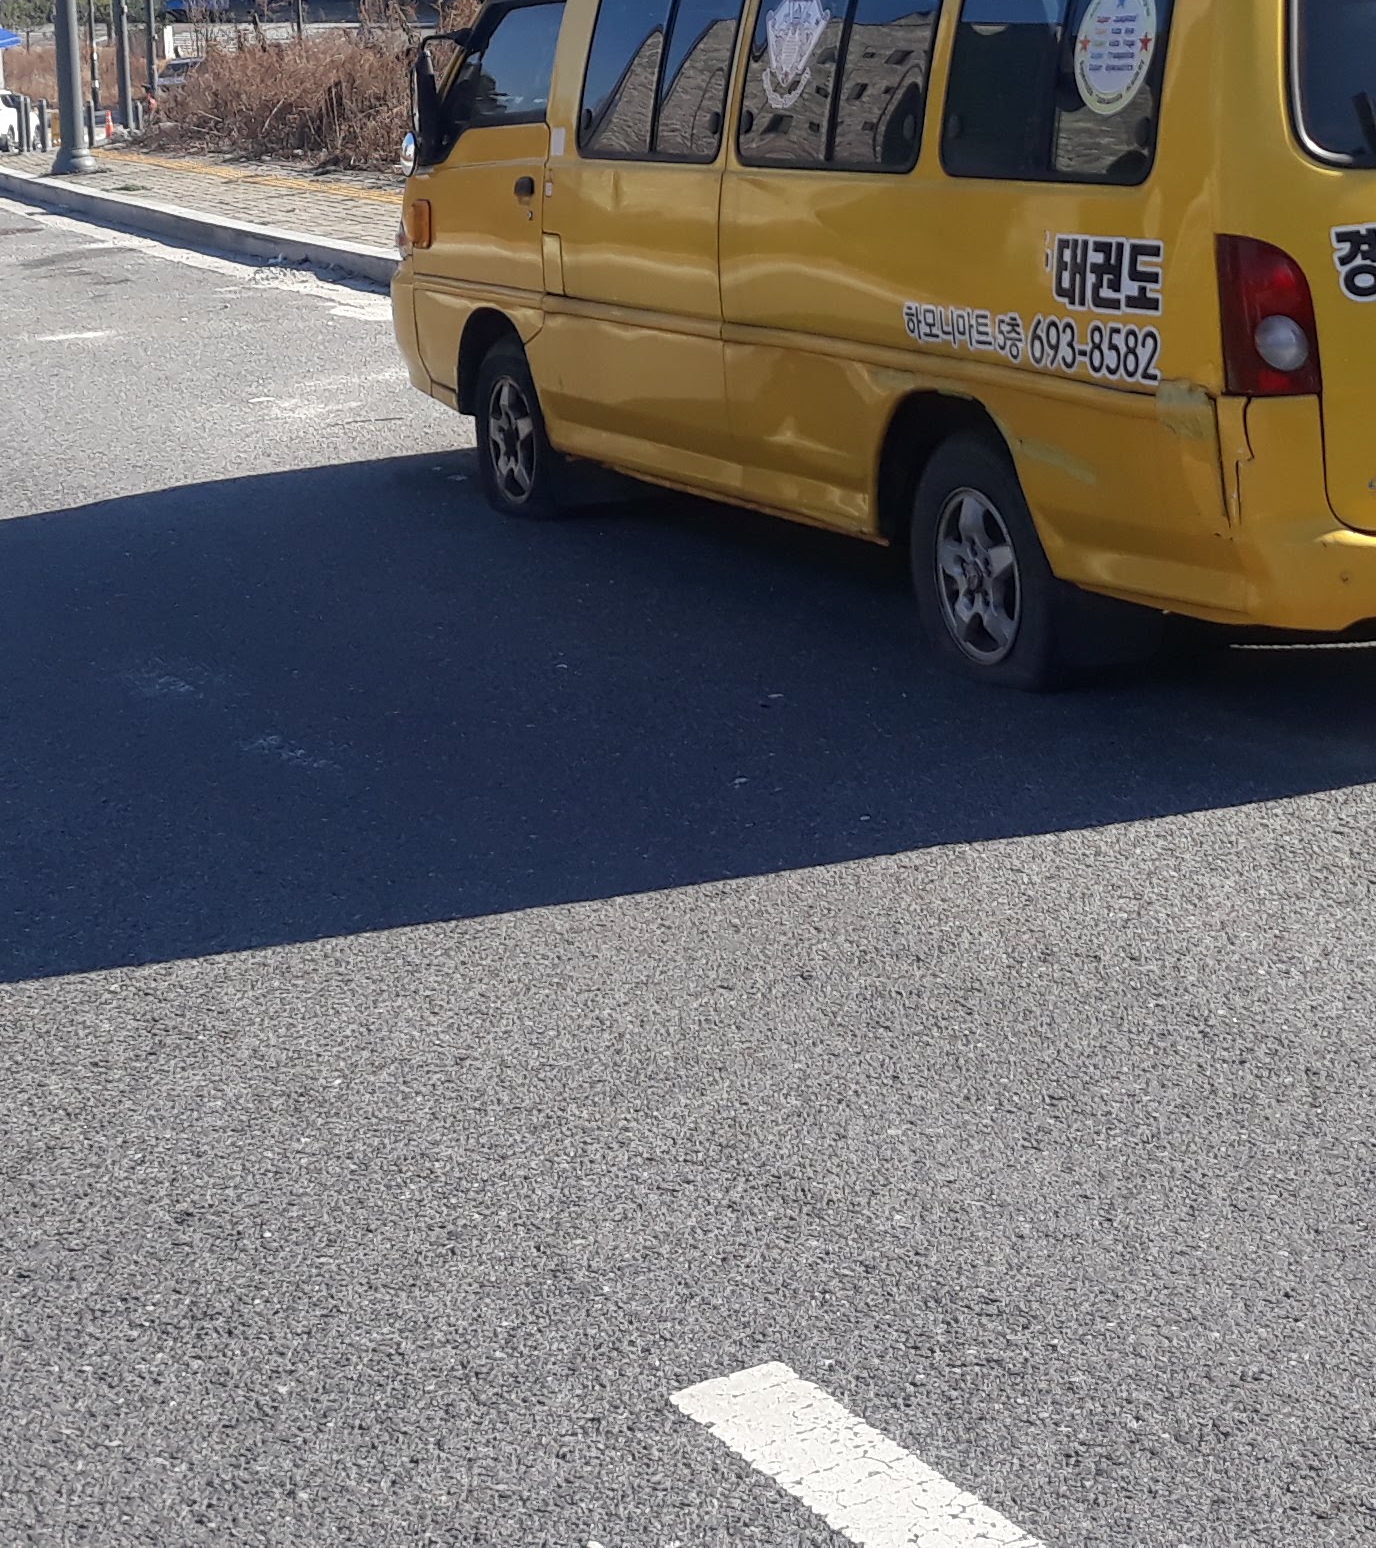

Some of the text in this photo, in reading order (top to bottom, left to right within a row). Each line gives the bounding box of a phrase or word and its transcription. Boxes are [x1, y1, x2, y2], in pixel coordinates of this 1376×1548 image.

[1055, 236, 1162, 312] 태권도
[904, 304, 1160, 382] 하모니마트 5층 693-8582
